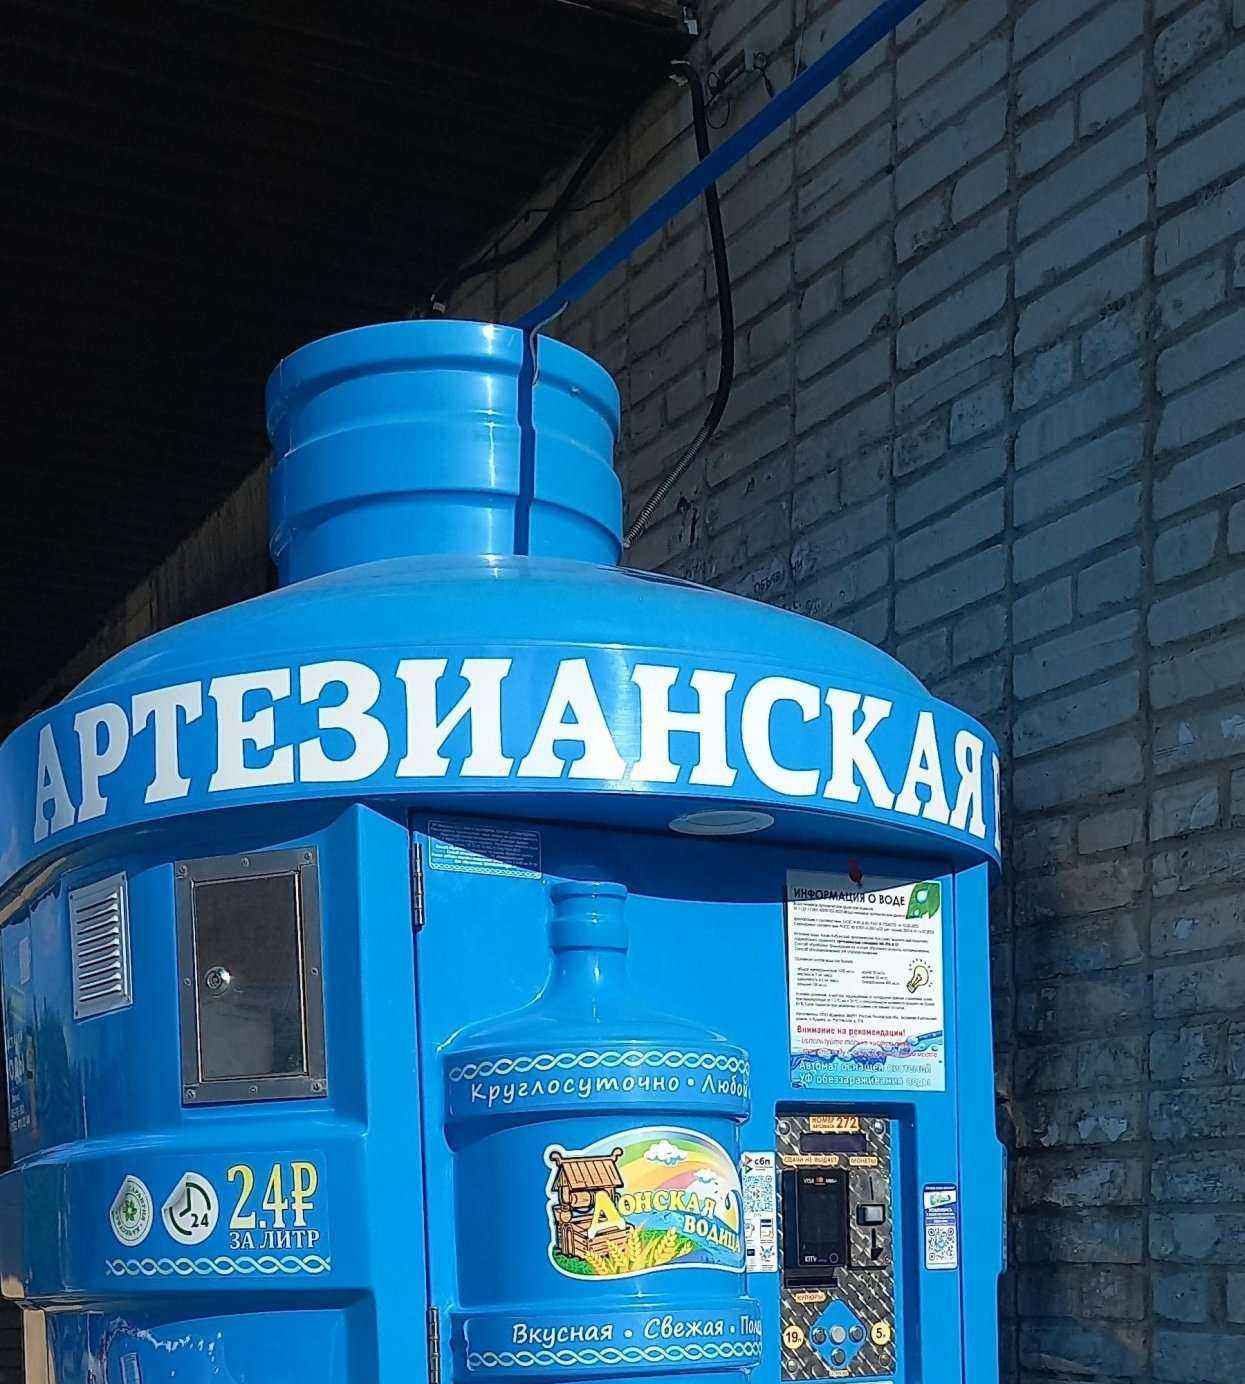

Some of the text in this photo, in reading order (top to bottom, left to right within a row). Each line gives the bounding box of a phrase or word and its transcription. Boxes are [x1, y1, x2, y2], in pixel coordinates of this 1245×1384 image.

[34, 658, 986, 843] АРТЕЗИАНСКАЯ
[793, 888, 905, 906] ИНФОРМАЦИЯ О ВОДЕ
[471, 1075, 680, 1107] Круглосуточно
[836, 1117, 858, 1129] 272
[190, 1213, 210, 1228] 24
[229, 1230, 320, 1250] ЗА ЛИТР
[512, 1322, 614, 1349] Вкусная
[643, 1315, 724, 1339] Свежая
